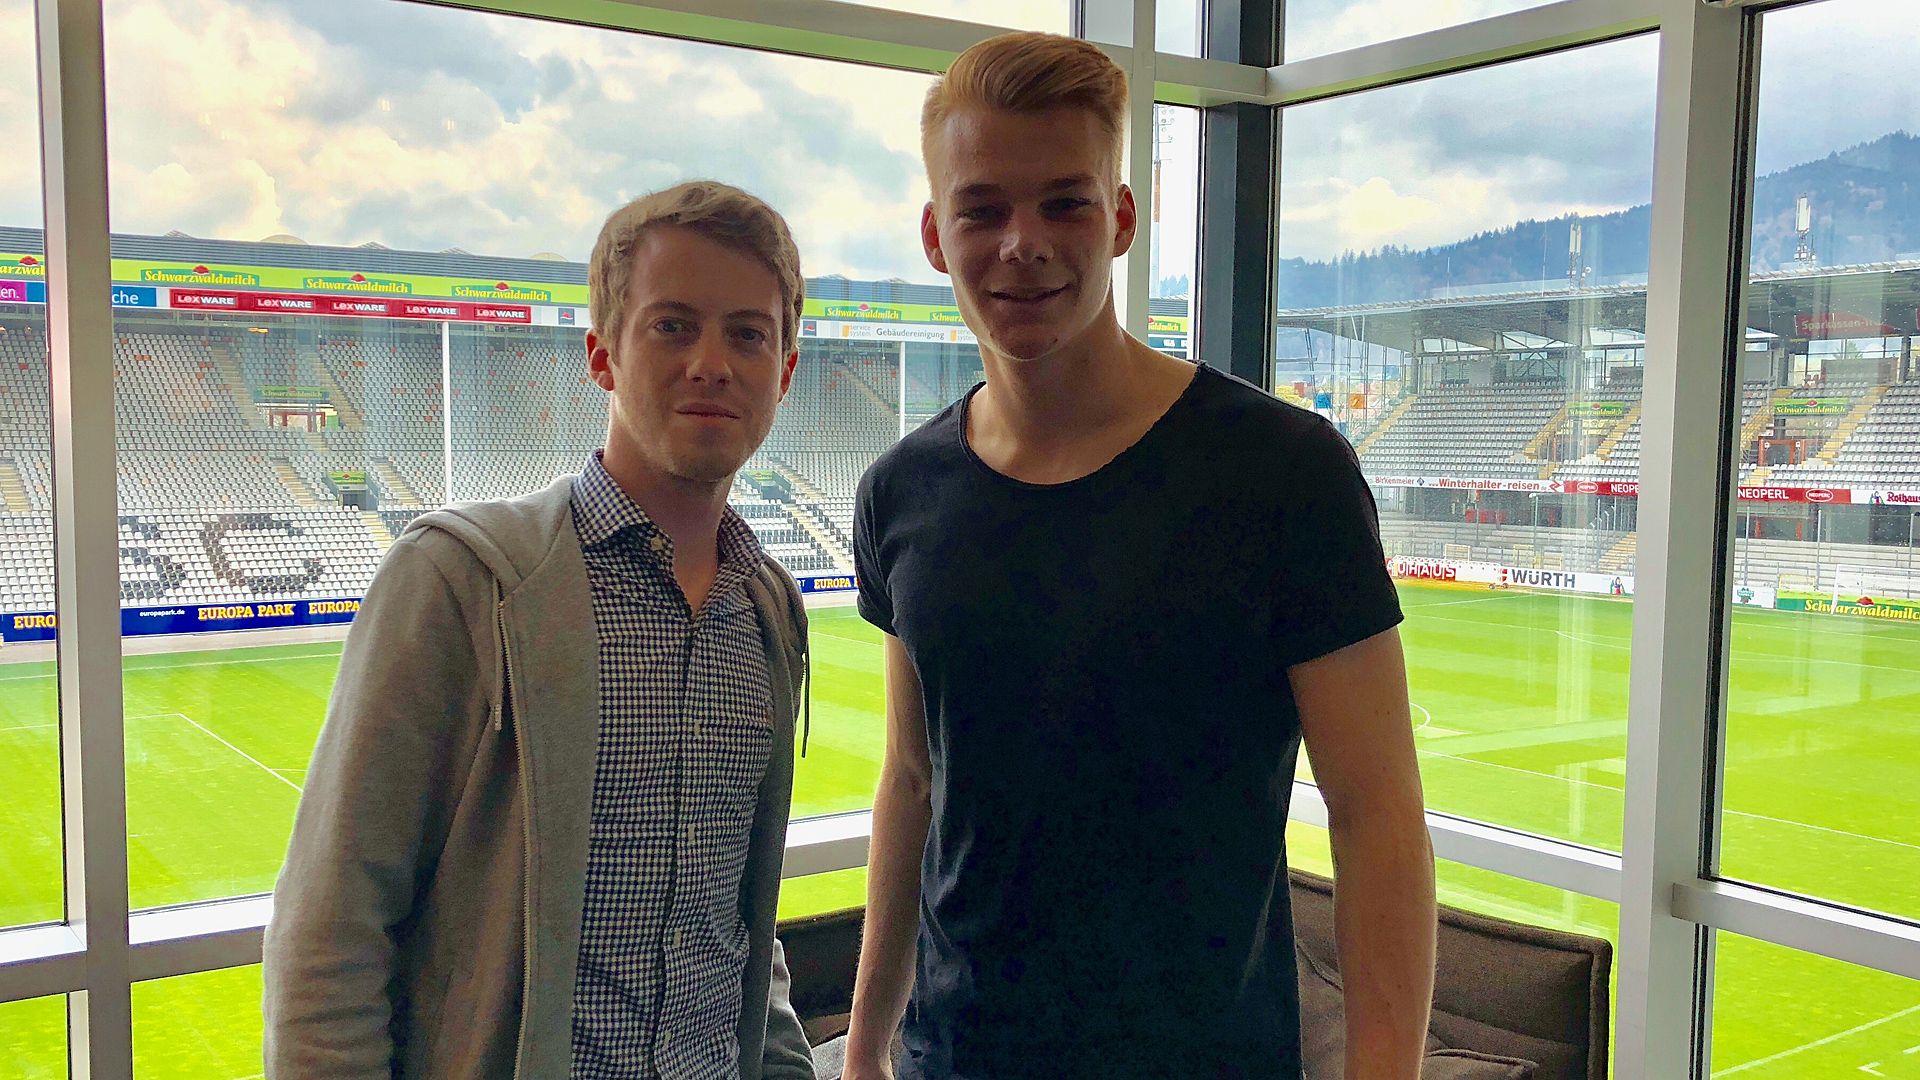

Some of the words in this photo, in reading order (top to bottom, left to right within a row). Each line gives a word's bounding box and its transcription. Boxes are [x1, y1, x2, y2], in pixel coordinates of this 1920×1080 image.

[145, 270, 256, 286] Schwarzwaldmilch
[306, 278, 408, 293] Schwarzwaldmilch
[112, 290, 139, 304] che
[455, 286, 548, 301] Schwarzwaldmilch
[827, 307, 899, 320] Schwarzwaldmilch
[876, 328, 944, 340] Gebäudereinigung
[1737, 488, 1789, 499] NEOPERL
[814, 577, 851, 590] EUROPA
[139, 609, 185, 617] europapark.de
[198, 606, 254, 620] EUROPA
[257, 603, 297, 617] PARK
[308, 601, 360, 614] EUROPA
[14, 615, 56, 629] EURO
